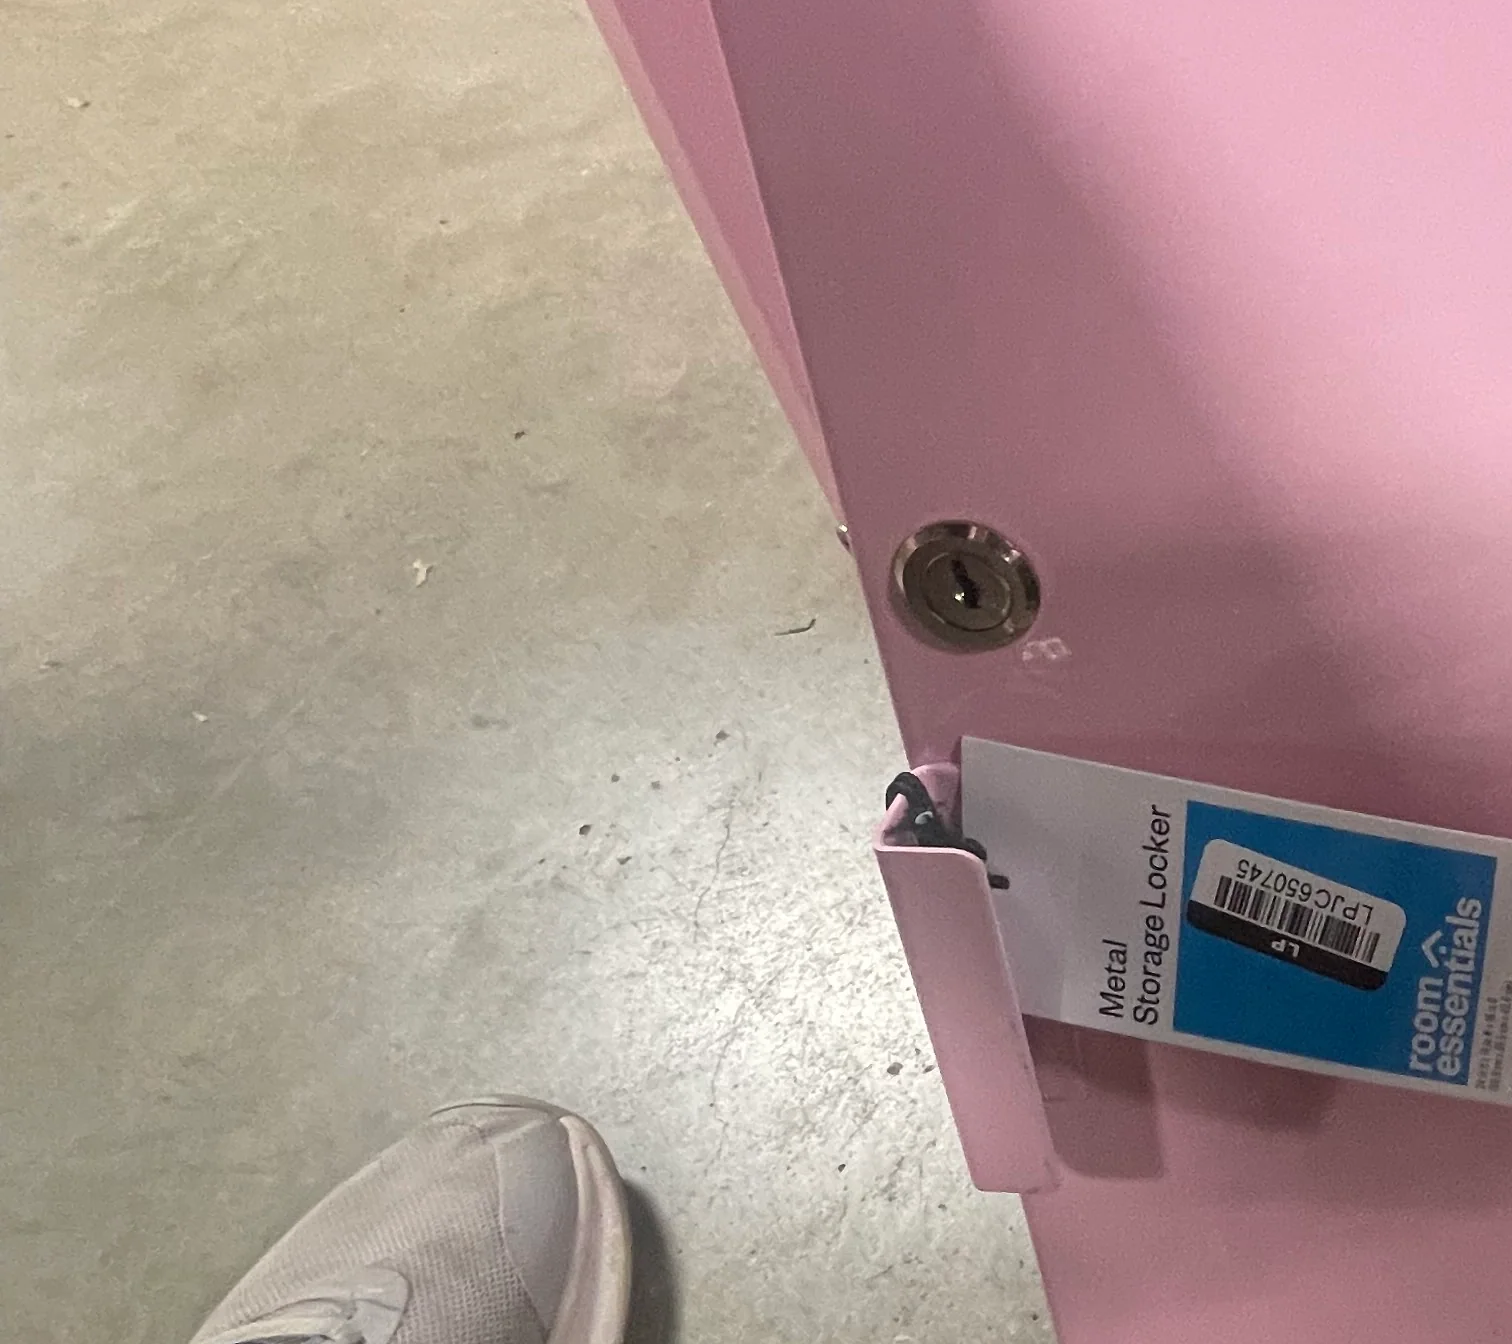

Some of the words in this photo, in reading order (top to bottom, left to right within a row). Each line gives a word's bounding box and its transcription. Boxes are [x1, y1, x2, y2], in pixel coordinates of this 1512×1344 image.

[1139, 804, 1171, 909] Locker
[1236, 859, 1374, 926] LPJC650745
[1099, 939, 1127, 1018] Metal
[1133, 914, 1170, 1026] Storage
[1271, 939, 1300, 958] LP
[1436, 897, 1482, 1077] essentials
[1409, 977, 1444, 1072] room
